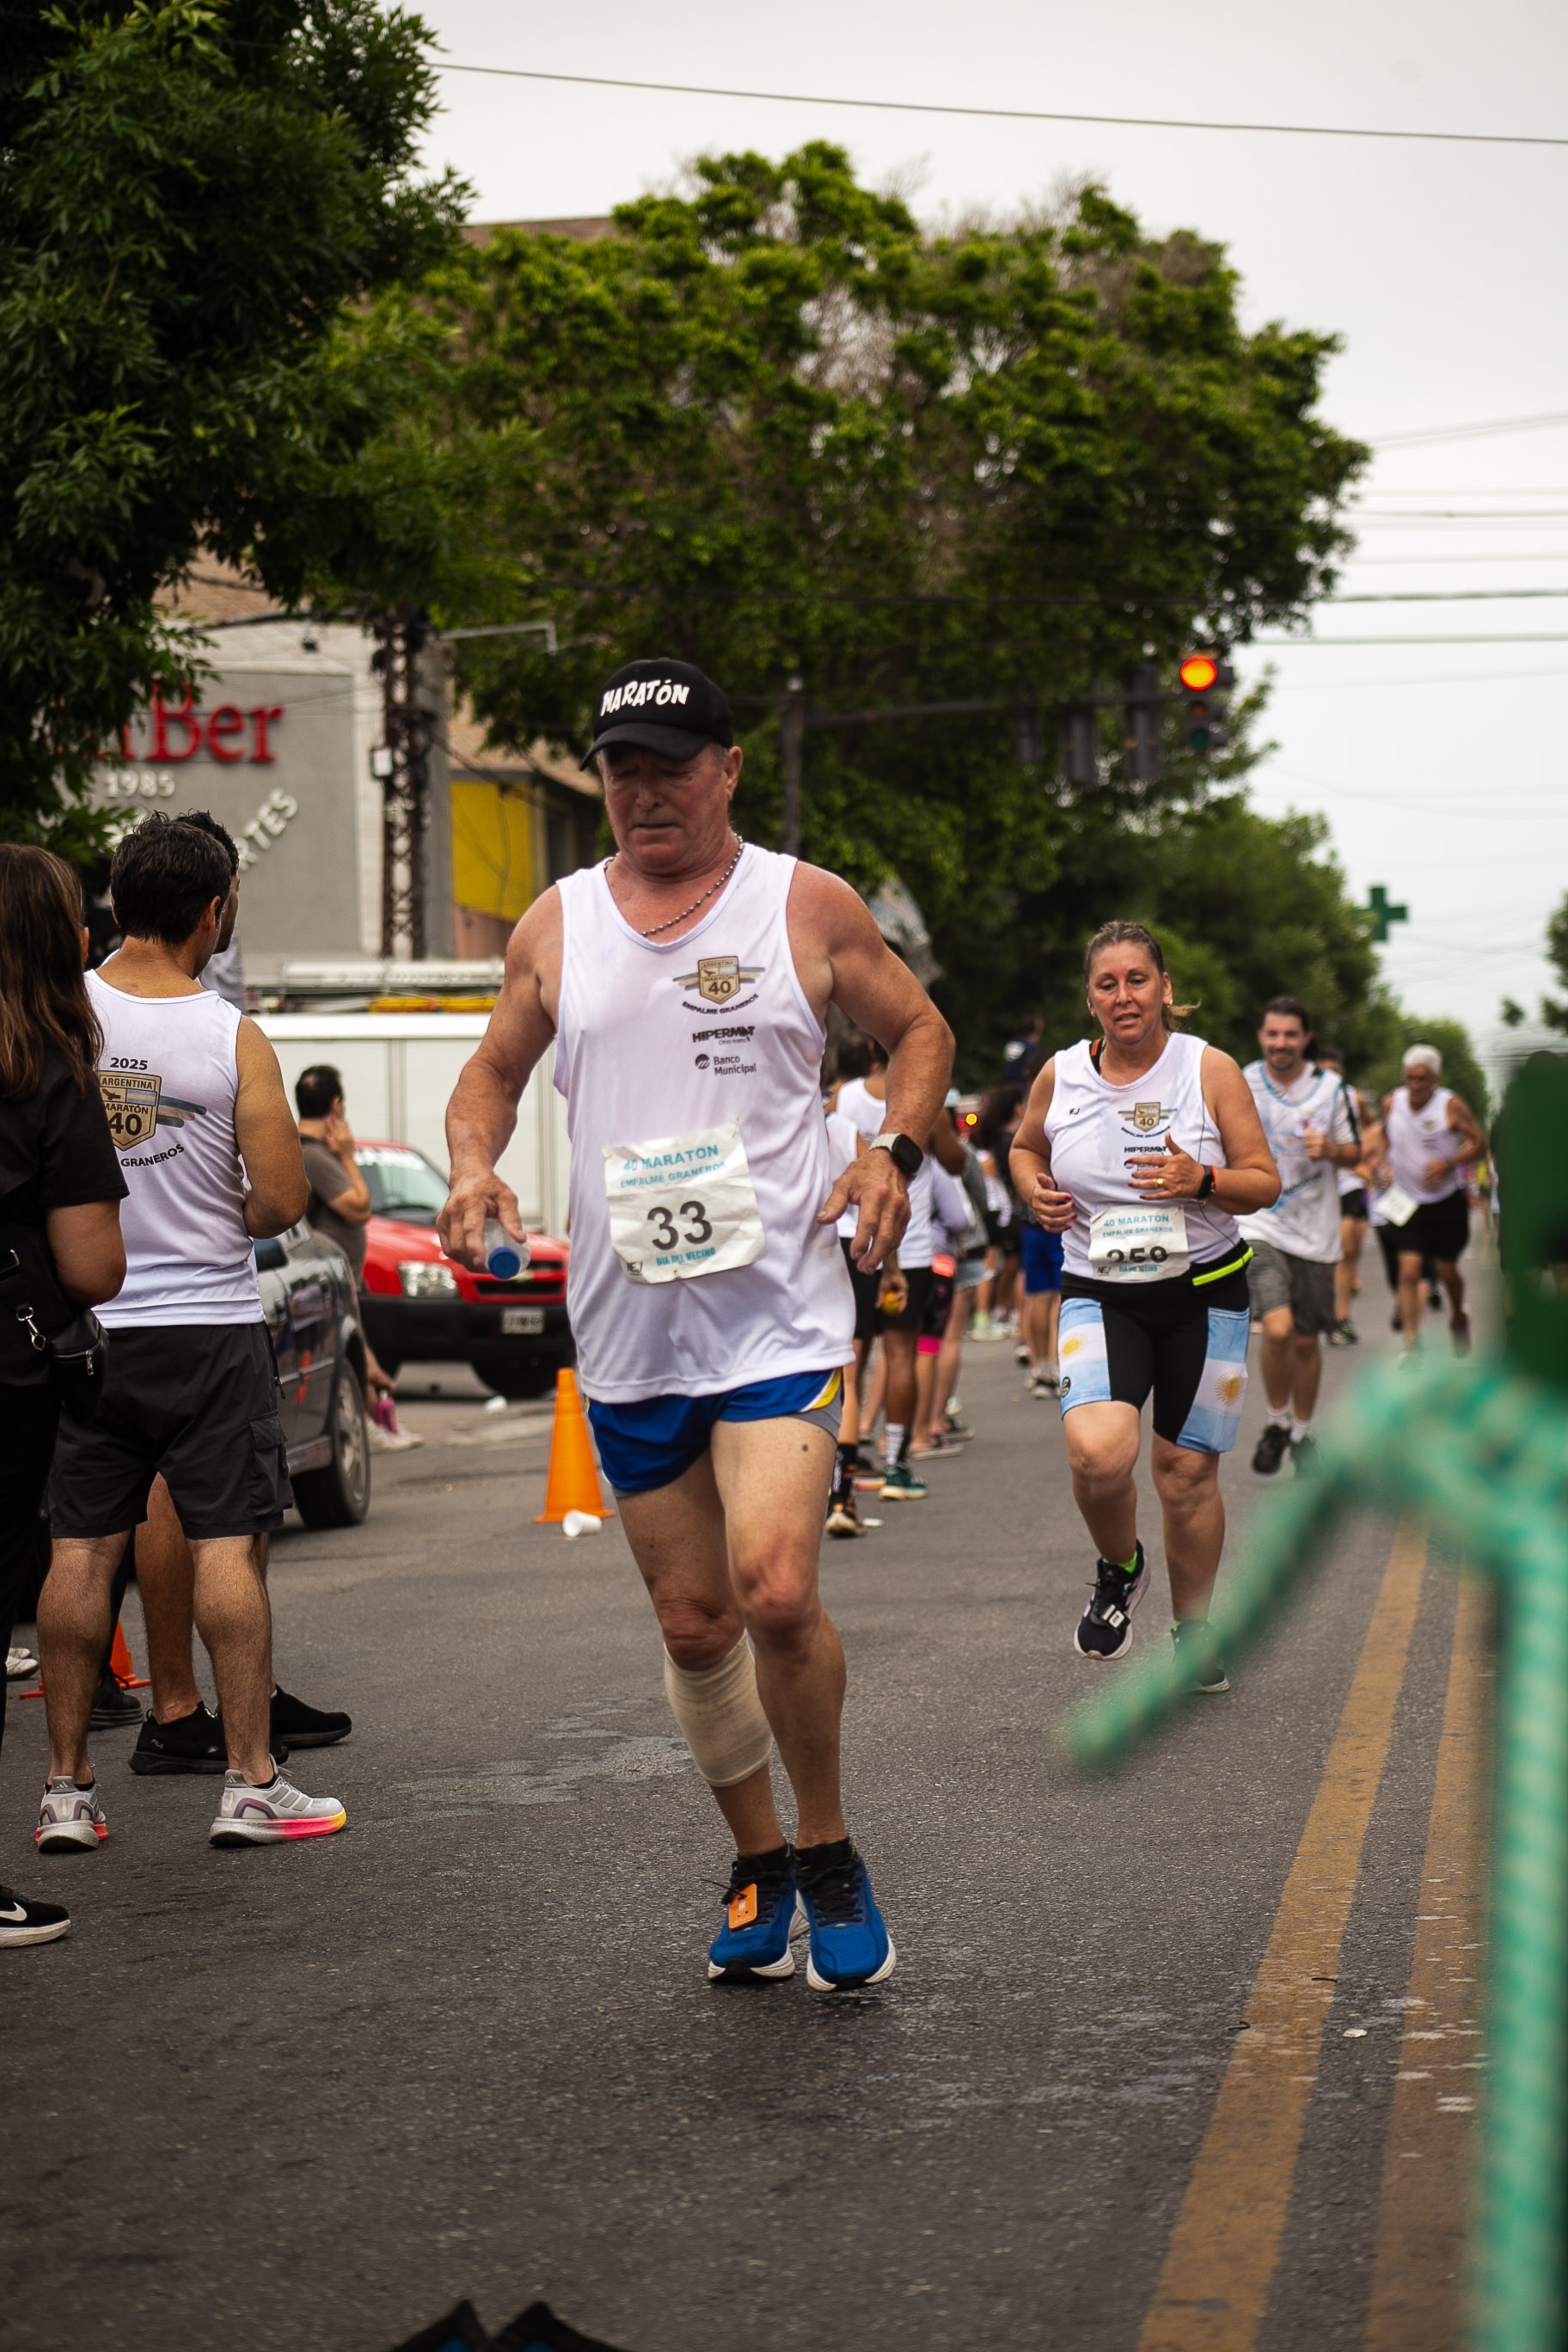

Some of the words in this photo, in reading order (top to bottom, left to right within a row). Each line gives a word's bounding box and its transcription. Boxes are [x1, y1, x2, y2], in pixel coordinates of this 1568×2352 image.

[600, 679, 690, 717] MARATÓN
[105, 770, 175, 798] 1985
[236, 787, 298, 872] RTES
[708, 980, 732, 995] 40
[682, 1001, 719, 1014] EMPALME
[109, 1057, 149, 1071] 2025
[714, 1056, 741, 1066] Banco
[714, 1063, 756, 1076] Municipal
[101, 1077, 153, 1090] ARGENTINA
[108, 1112, 143, 1136] 40
[1139, 1118, 1155, 1127] 40
[120, 1143, 185, 1167] GRANEROS
[623, 1160, 638, 1172] 40
[641, 1145, 720, 1169] MARATON
[620, 1174, 665, 1188] EMPALME
[646, 1200, 714, 1251] 33
[1103, 1219, 1115, 1228] 40
[1118, 1215, 1169, 1226] MARATON
